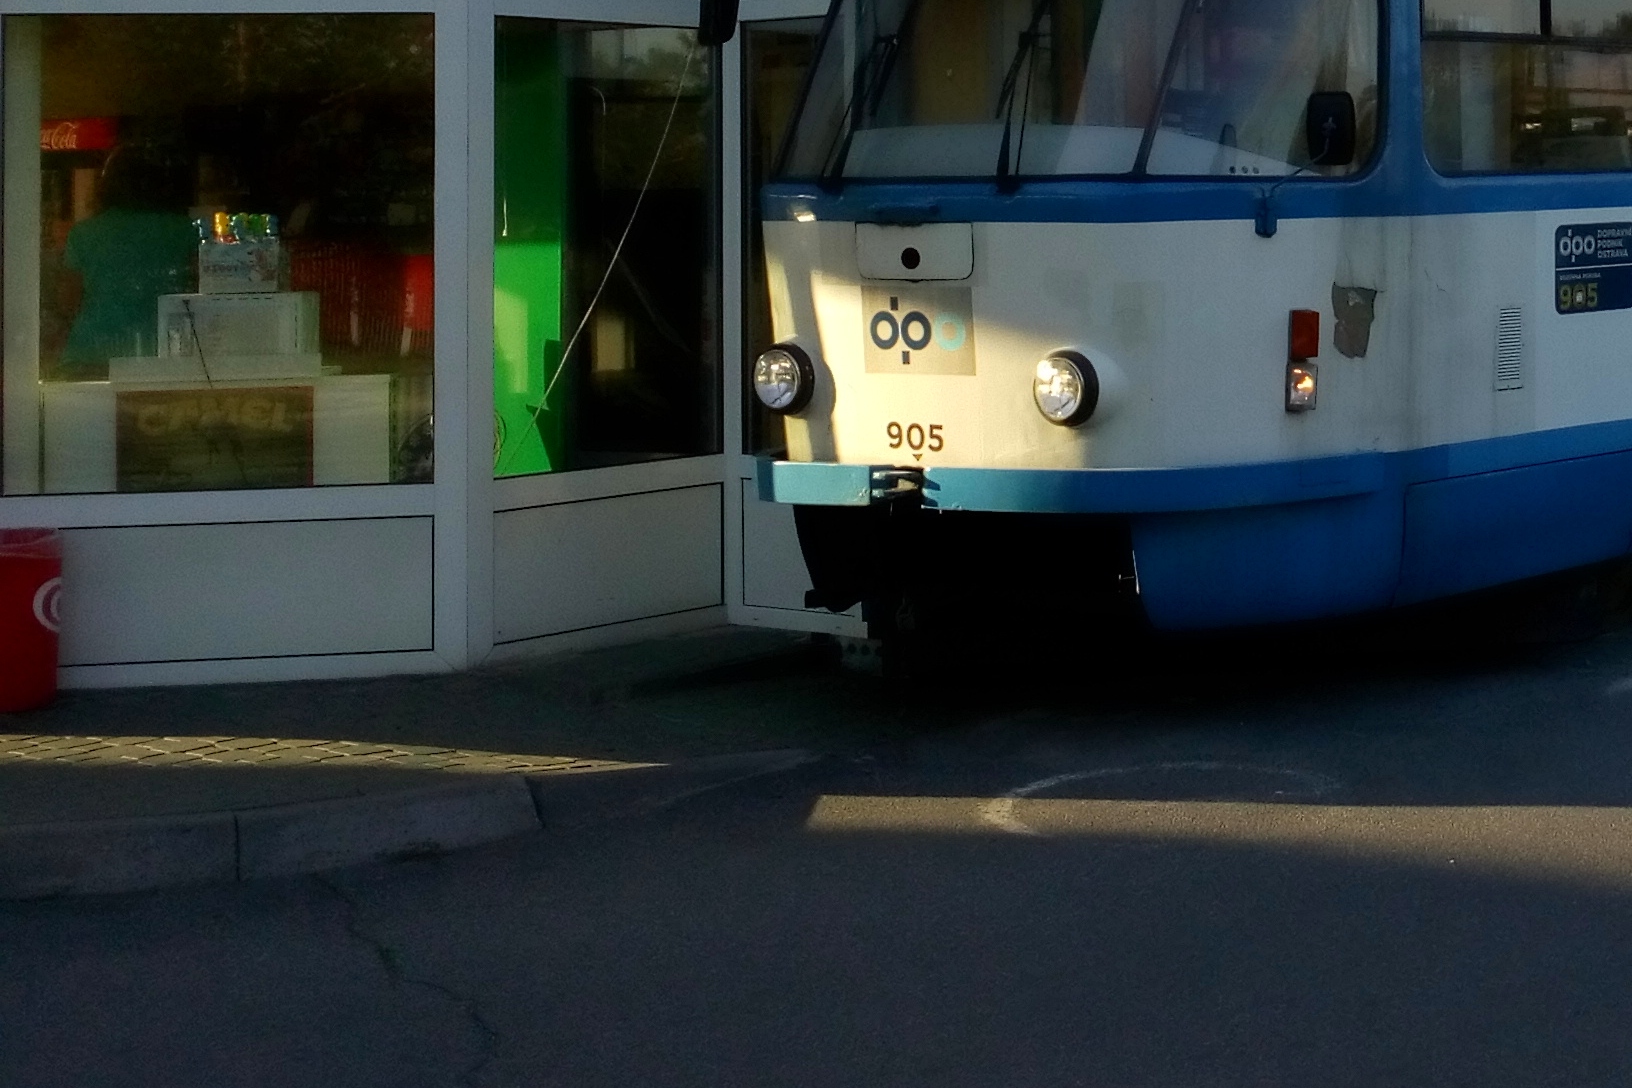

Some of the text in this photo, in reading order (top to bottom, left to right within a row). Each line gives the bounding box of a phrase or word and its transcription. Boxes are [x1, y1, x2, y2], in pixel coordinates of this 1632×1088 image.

[1597, 249, 1629, 258] OSTRAVA
[1560, 282, 1598, 310] 905
[887, 421, 944, 453] 905
